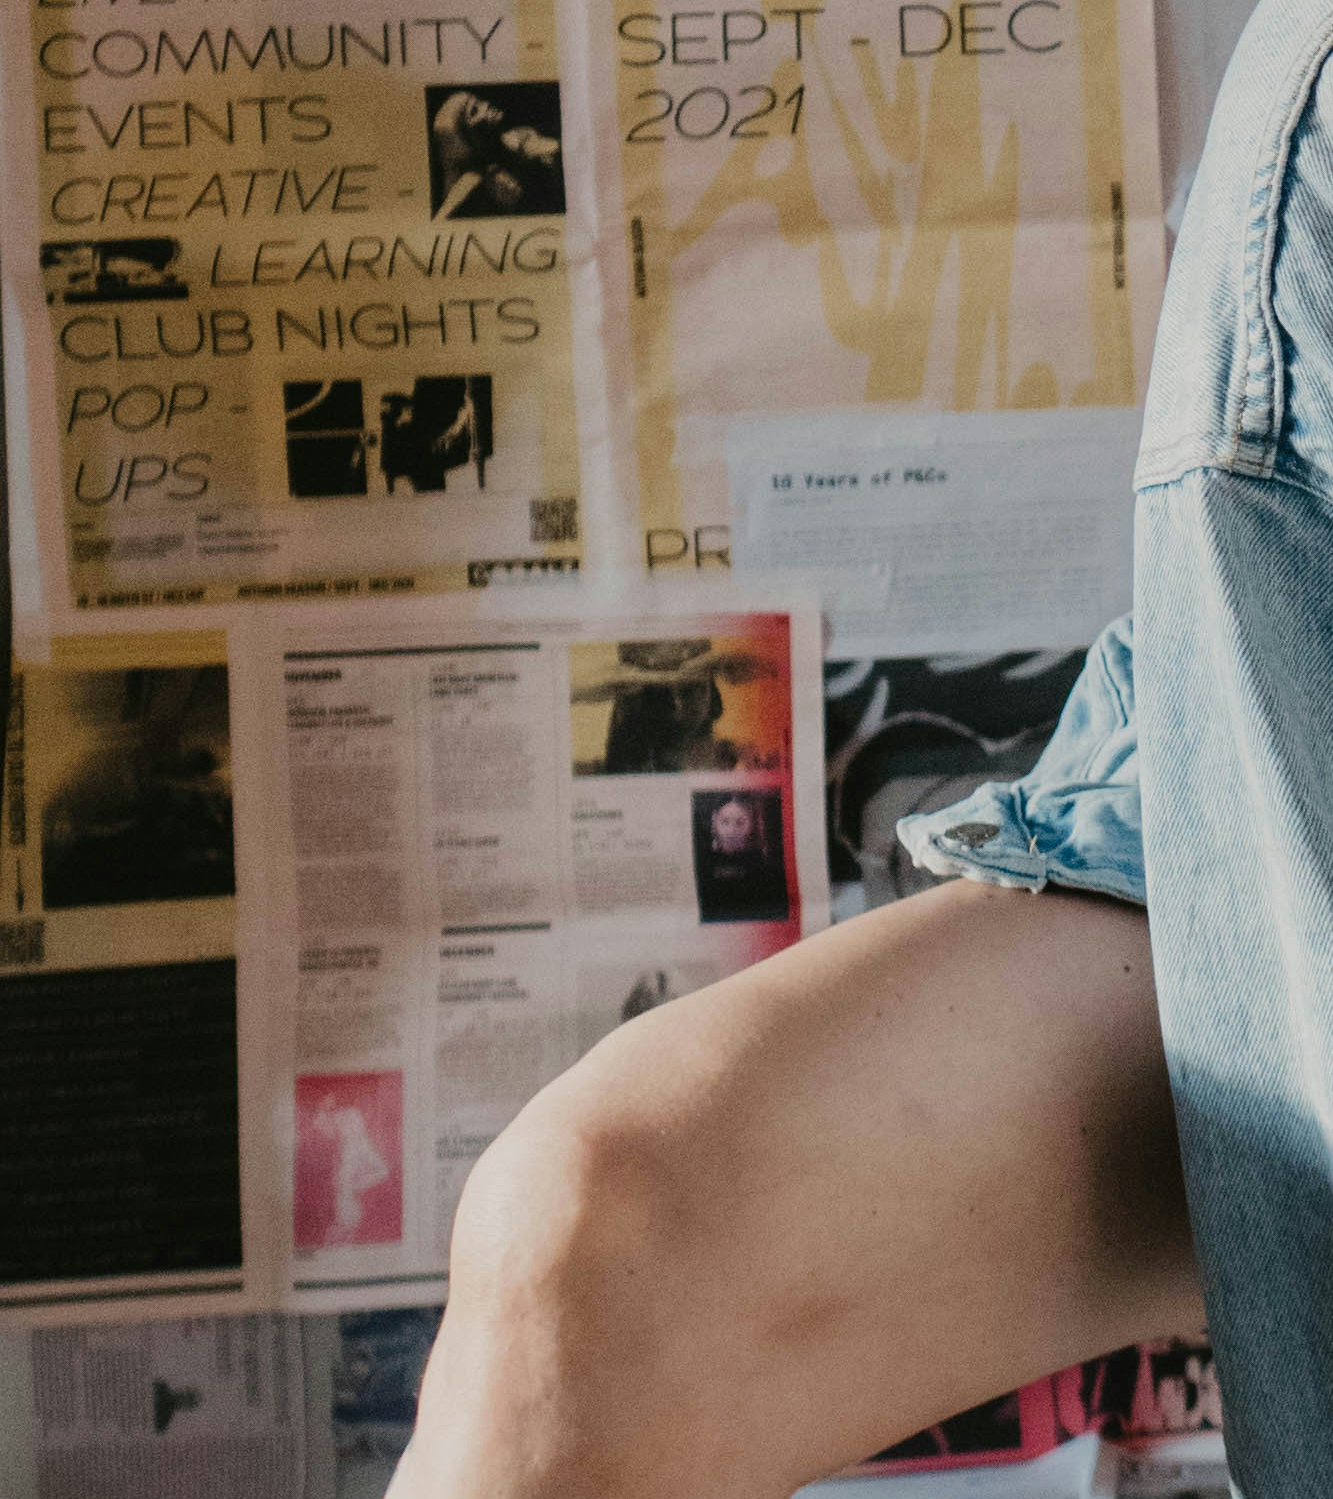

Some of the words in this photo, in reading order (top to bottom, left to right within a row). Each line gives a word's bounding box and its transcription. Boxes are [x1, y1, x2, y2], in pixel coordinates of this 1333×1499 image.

[39, 17, 503, 81] COMMUNITY
[617, 7, 825, 69] SEPT
[899, 0, 1063, 58] DEC
[45, 94, 334, 155] EVENTS
[625, 83, 807, 145] 2021
[50, 163, 379, 227] CREATIVE
[210, 226, 562, 289] LEARNING
[60, 307, 254, 365] CLUB
[276, 297, 541, 354] NIGHTS
[67, 381, 209, 437] POP
[74, 452, 212, 507] UPS
